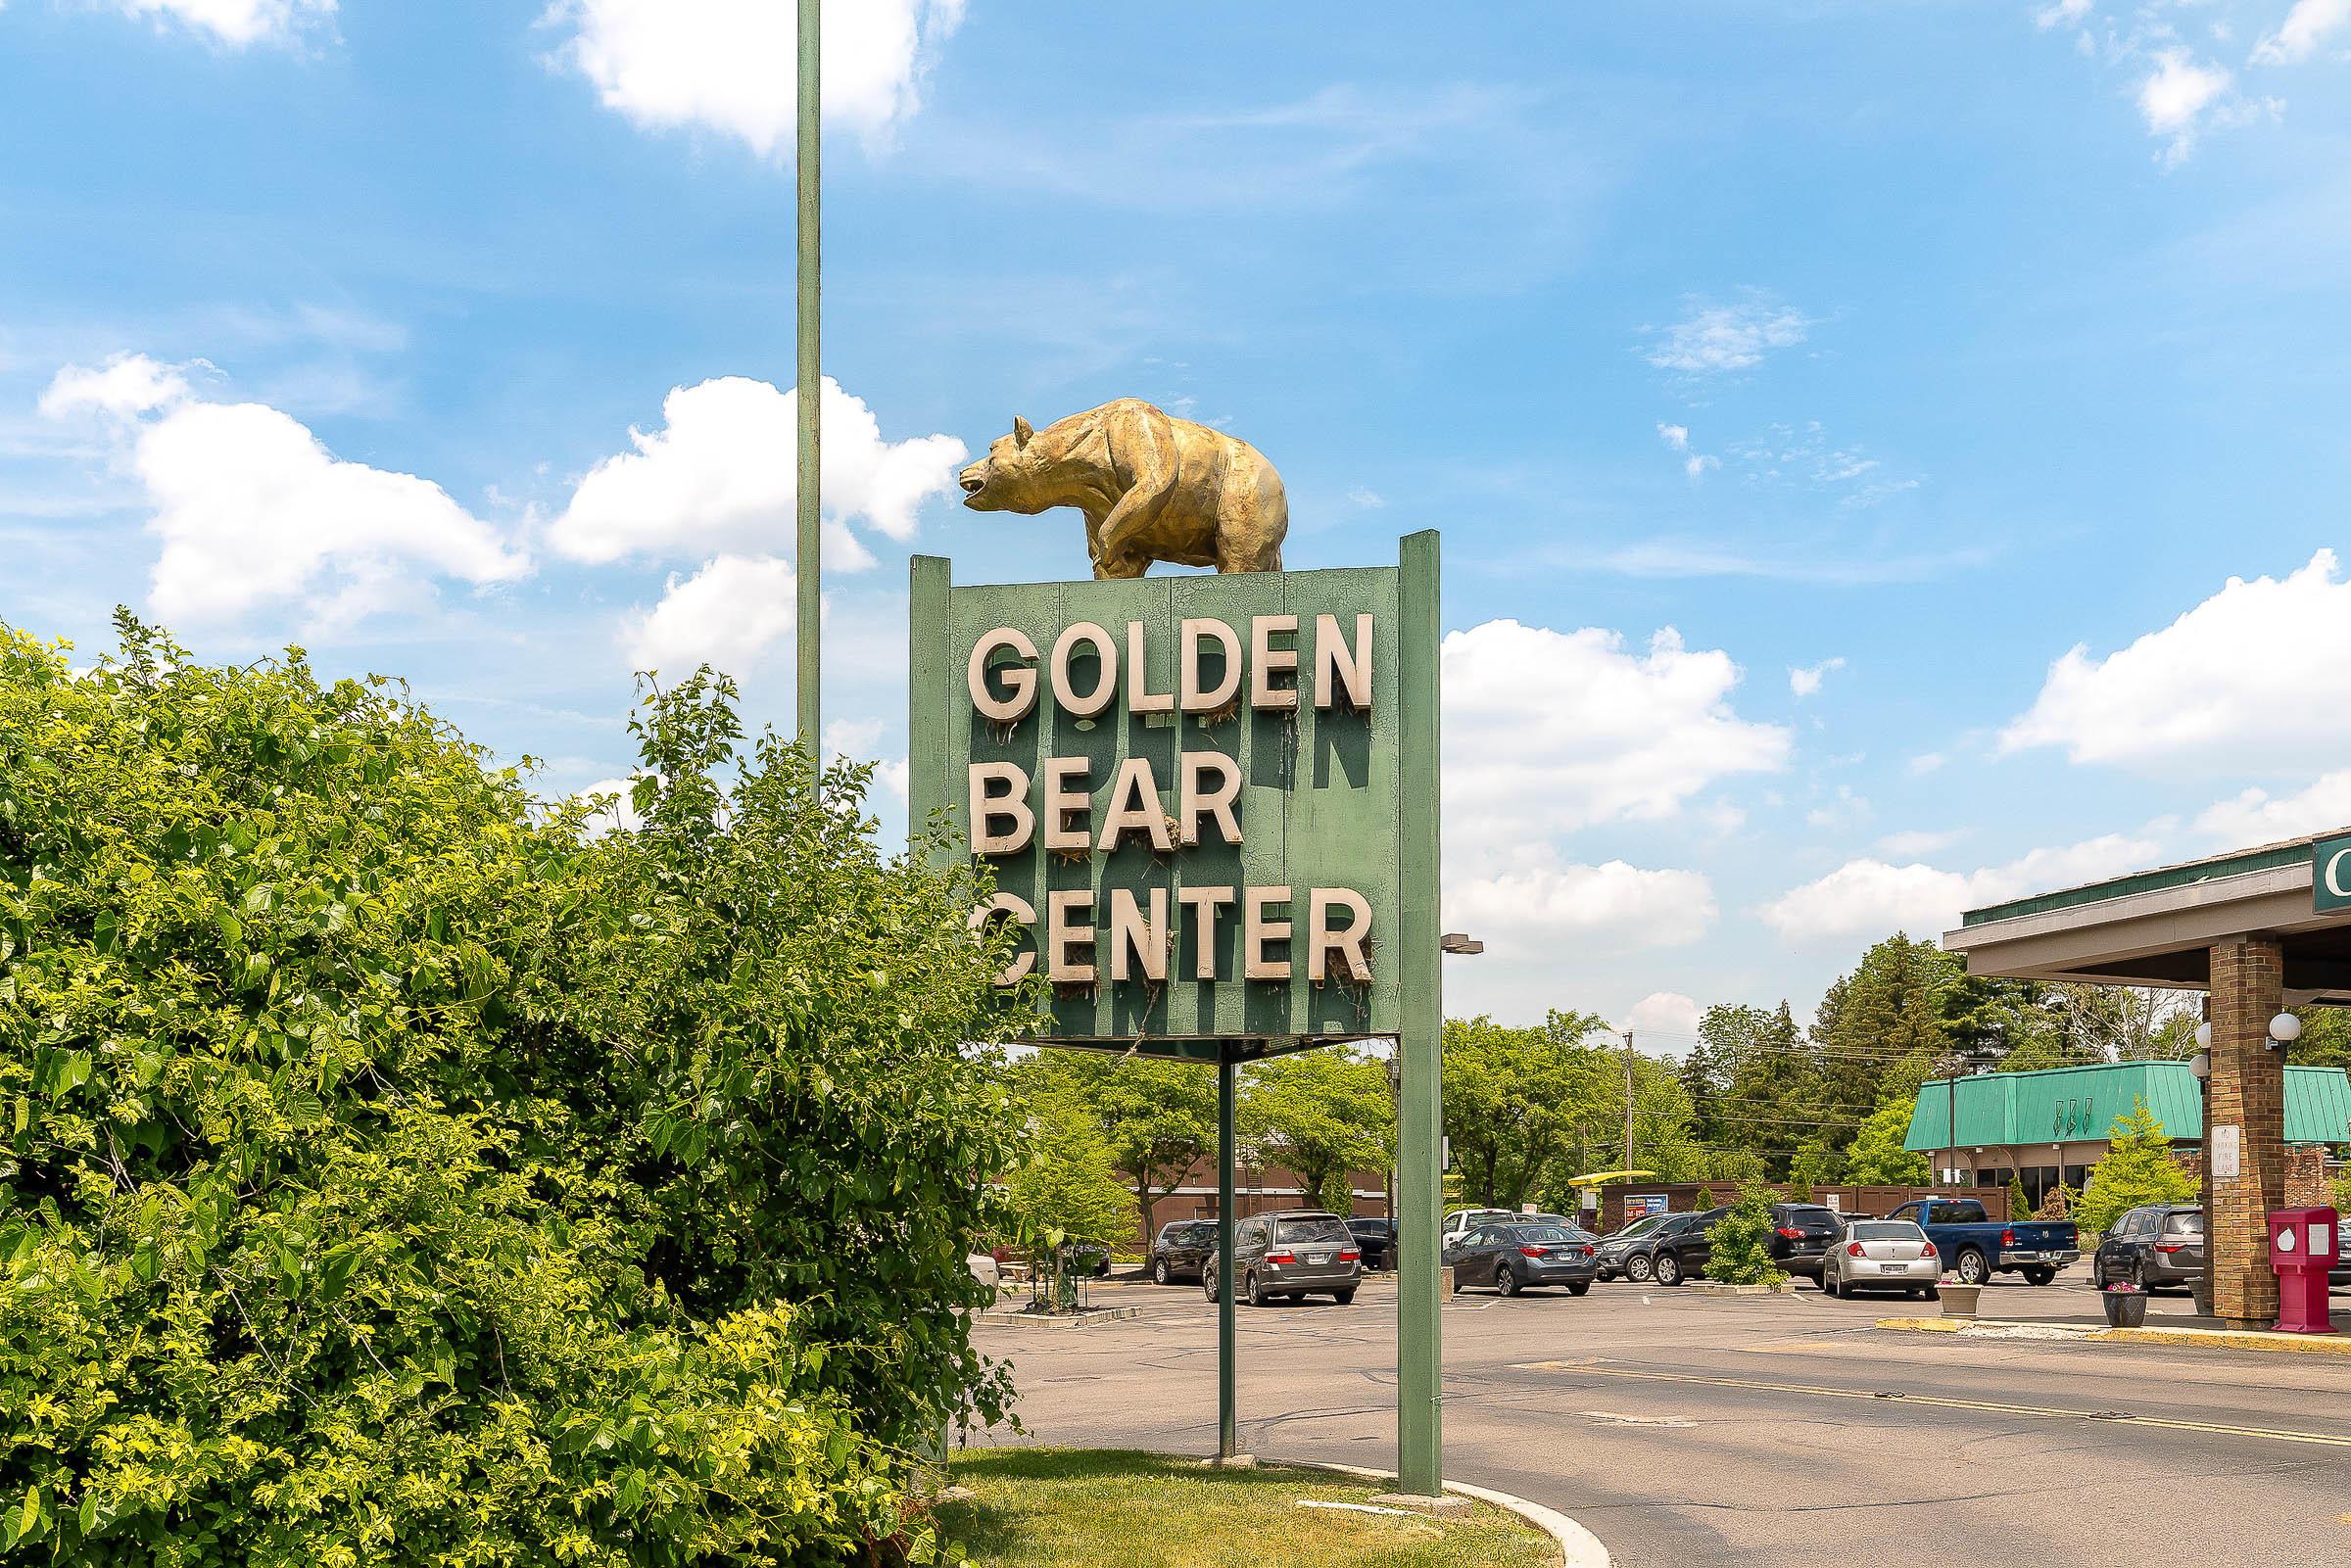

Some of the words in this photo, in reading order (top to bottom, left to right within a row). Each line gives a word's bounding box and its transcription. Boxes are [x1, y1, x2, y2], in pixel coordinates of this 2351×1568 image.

[967, 613, 1373, 721] GOLDEN
[968, 750, 1244, 855] BEAR
[967, 885, 1373, 988] CENTER
[2217, 1164, 2234, 1172] LANE
[2218, 1152, 2233, 1162] FIRE
